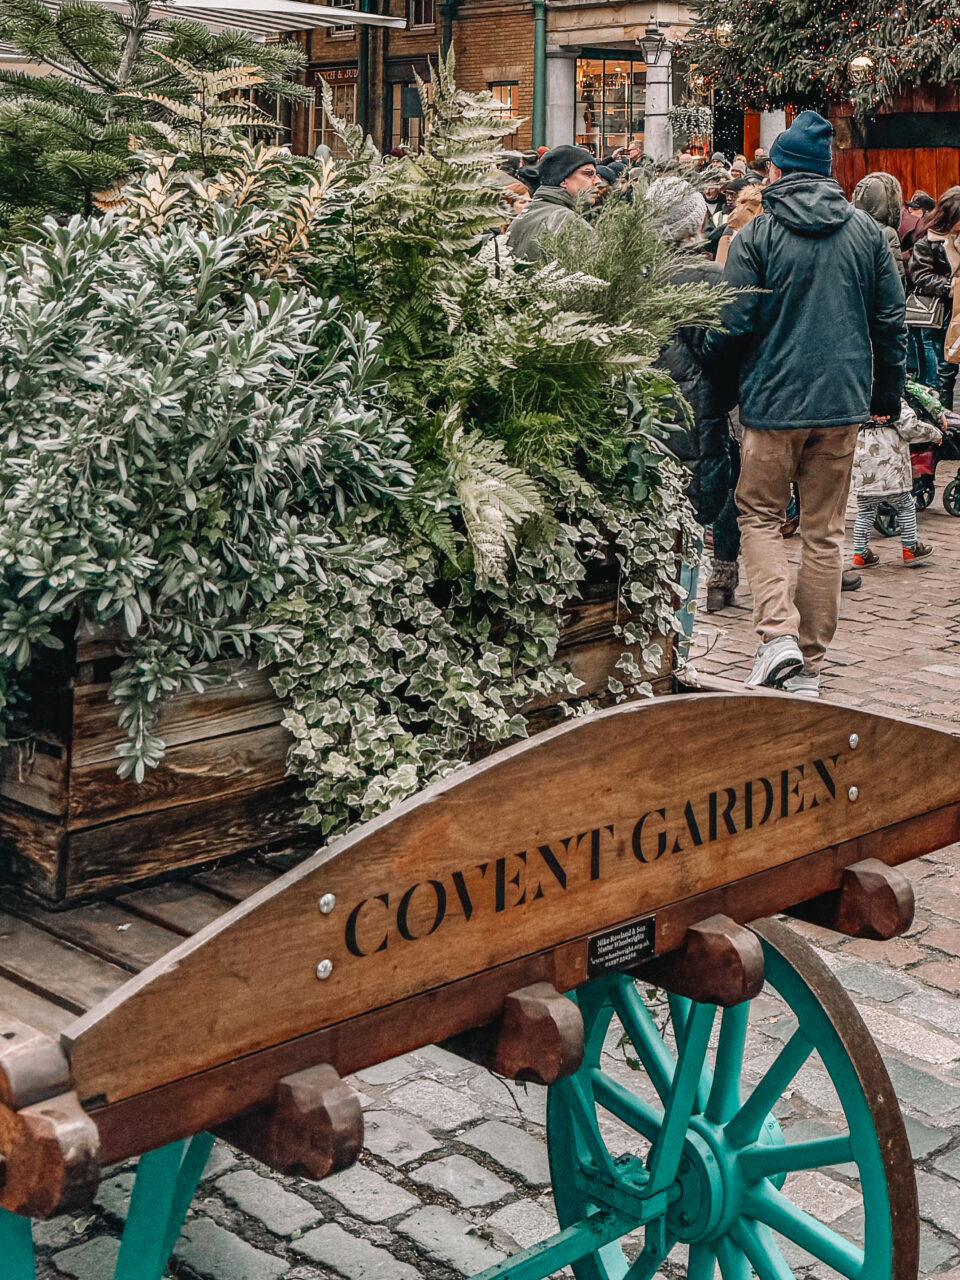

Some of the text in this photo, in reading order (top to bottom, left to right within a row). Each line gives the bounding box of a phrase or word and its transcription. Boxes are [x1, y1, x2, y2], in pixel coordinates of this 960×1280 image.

[337, 70, 343, 79] &
[344, 69, 359, 78] JUD
[344, 753, 844, 957] COVENT GARDEN
[631, 927, 636, 935] &
